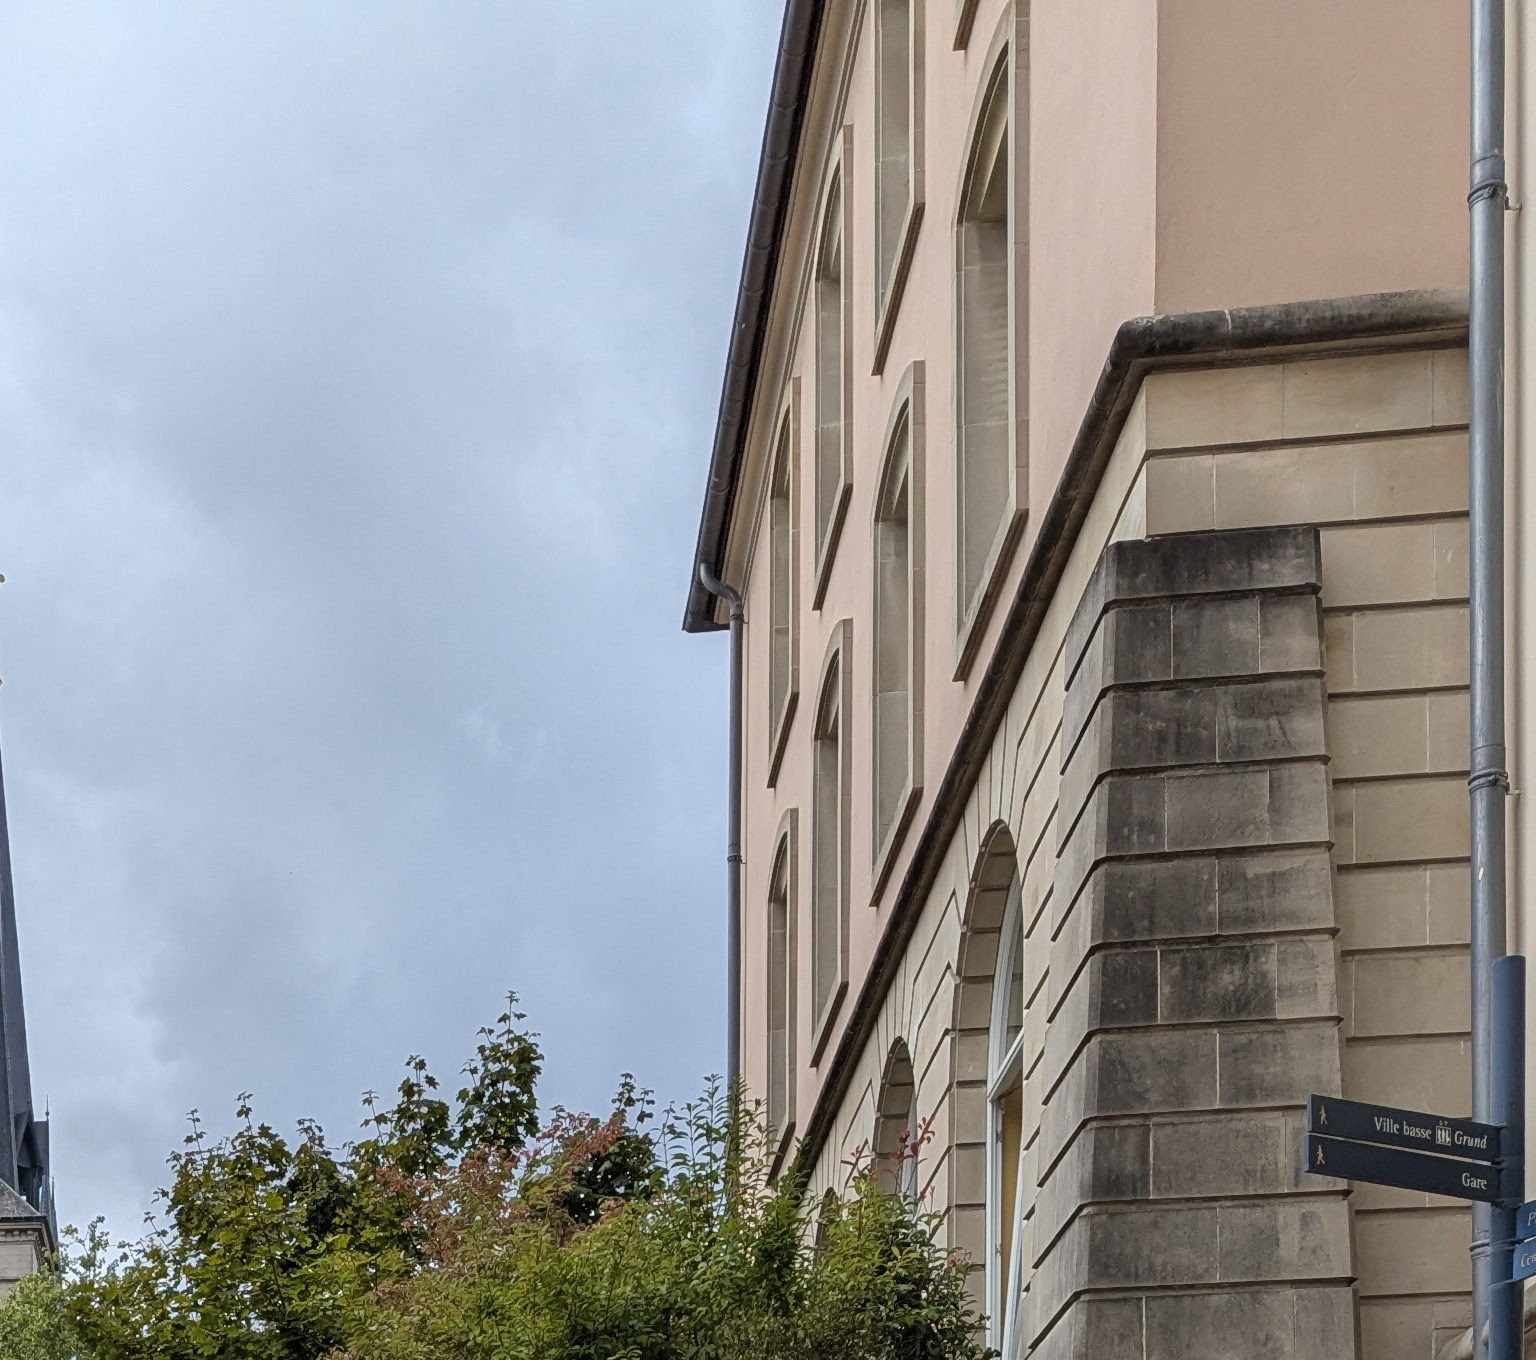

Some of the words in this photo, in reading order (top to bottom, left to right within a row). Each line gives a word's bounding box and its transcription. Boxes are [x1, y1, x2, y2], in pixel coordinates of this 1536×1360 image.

[1374, 1116, 1400, 1135] Ville
[1403, 1121, 1432, 1140] basse
[1454, 1130, 1488, 1149] Grund
[1462, 1173, 1488, 1190] Gare
